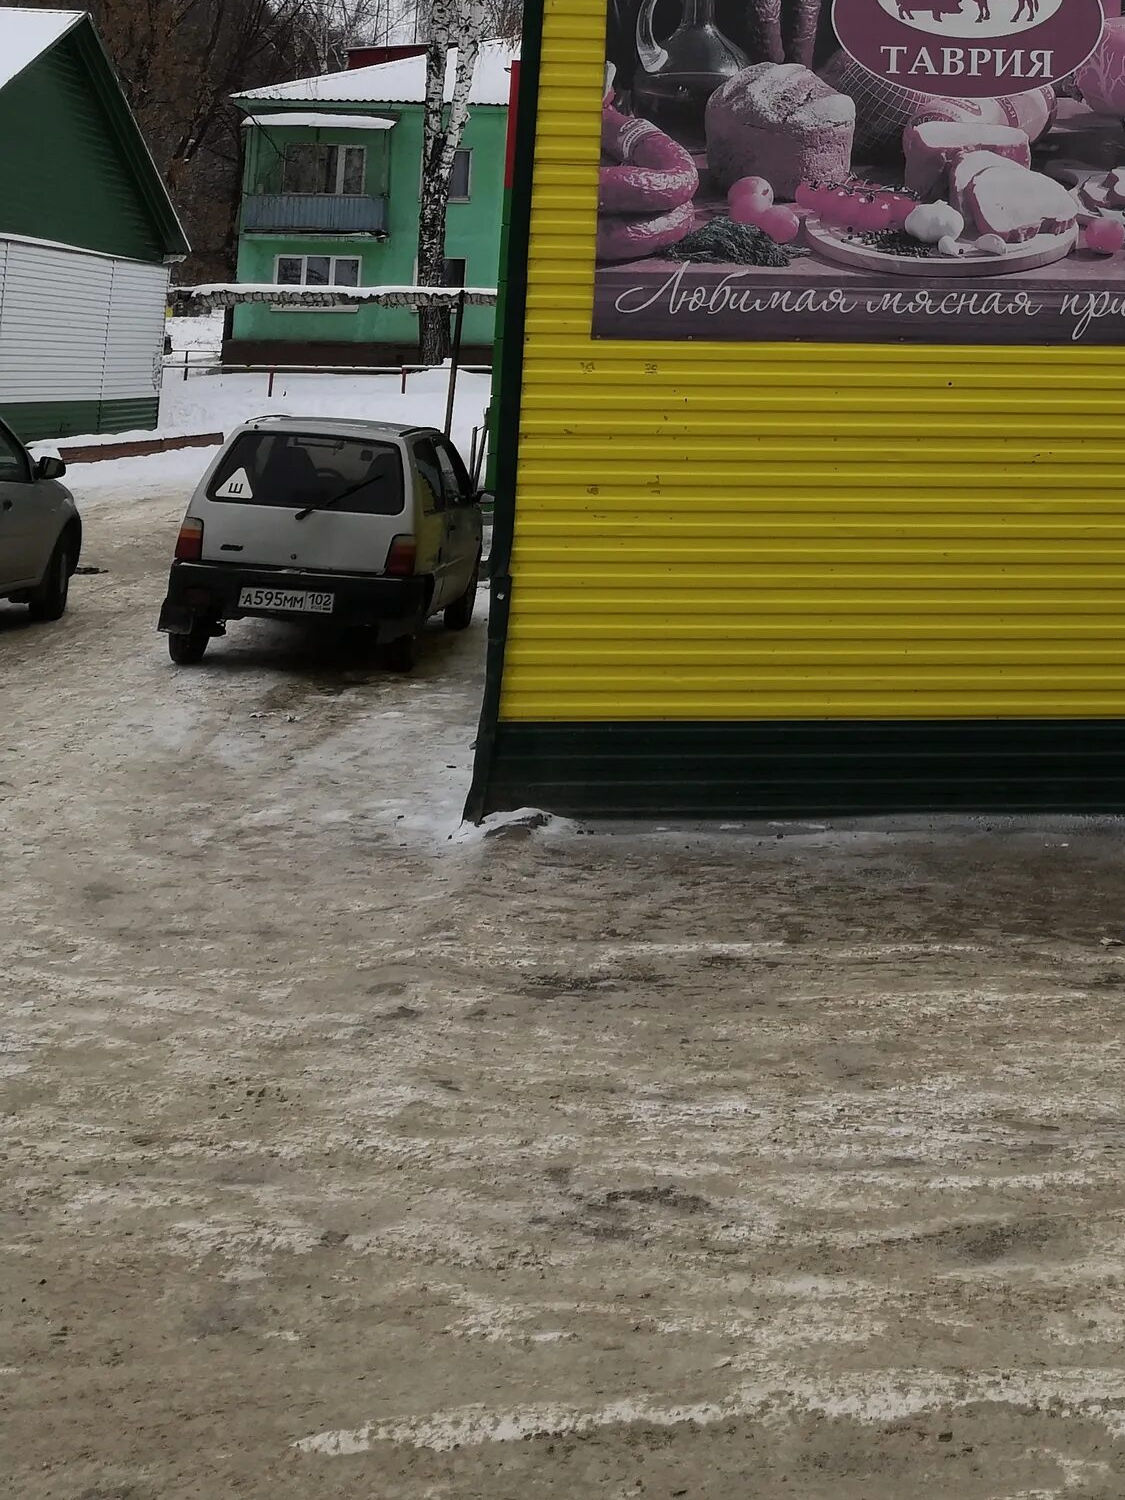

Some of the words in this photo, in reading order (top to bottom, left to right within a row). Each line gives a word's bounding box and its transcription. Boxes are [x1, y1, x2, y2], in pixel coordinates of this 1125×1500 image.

[880, 44, 1056, 80] ТАВРИЯ
[615, 260, 858, 315] Любимая
[866, 288, 1043, 317] мясная
